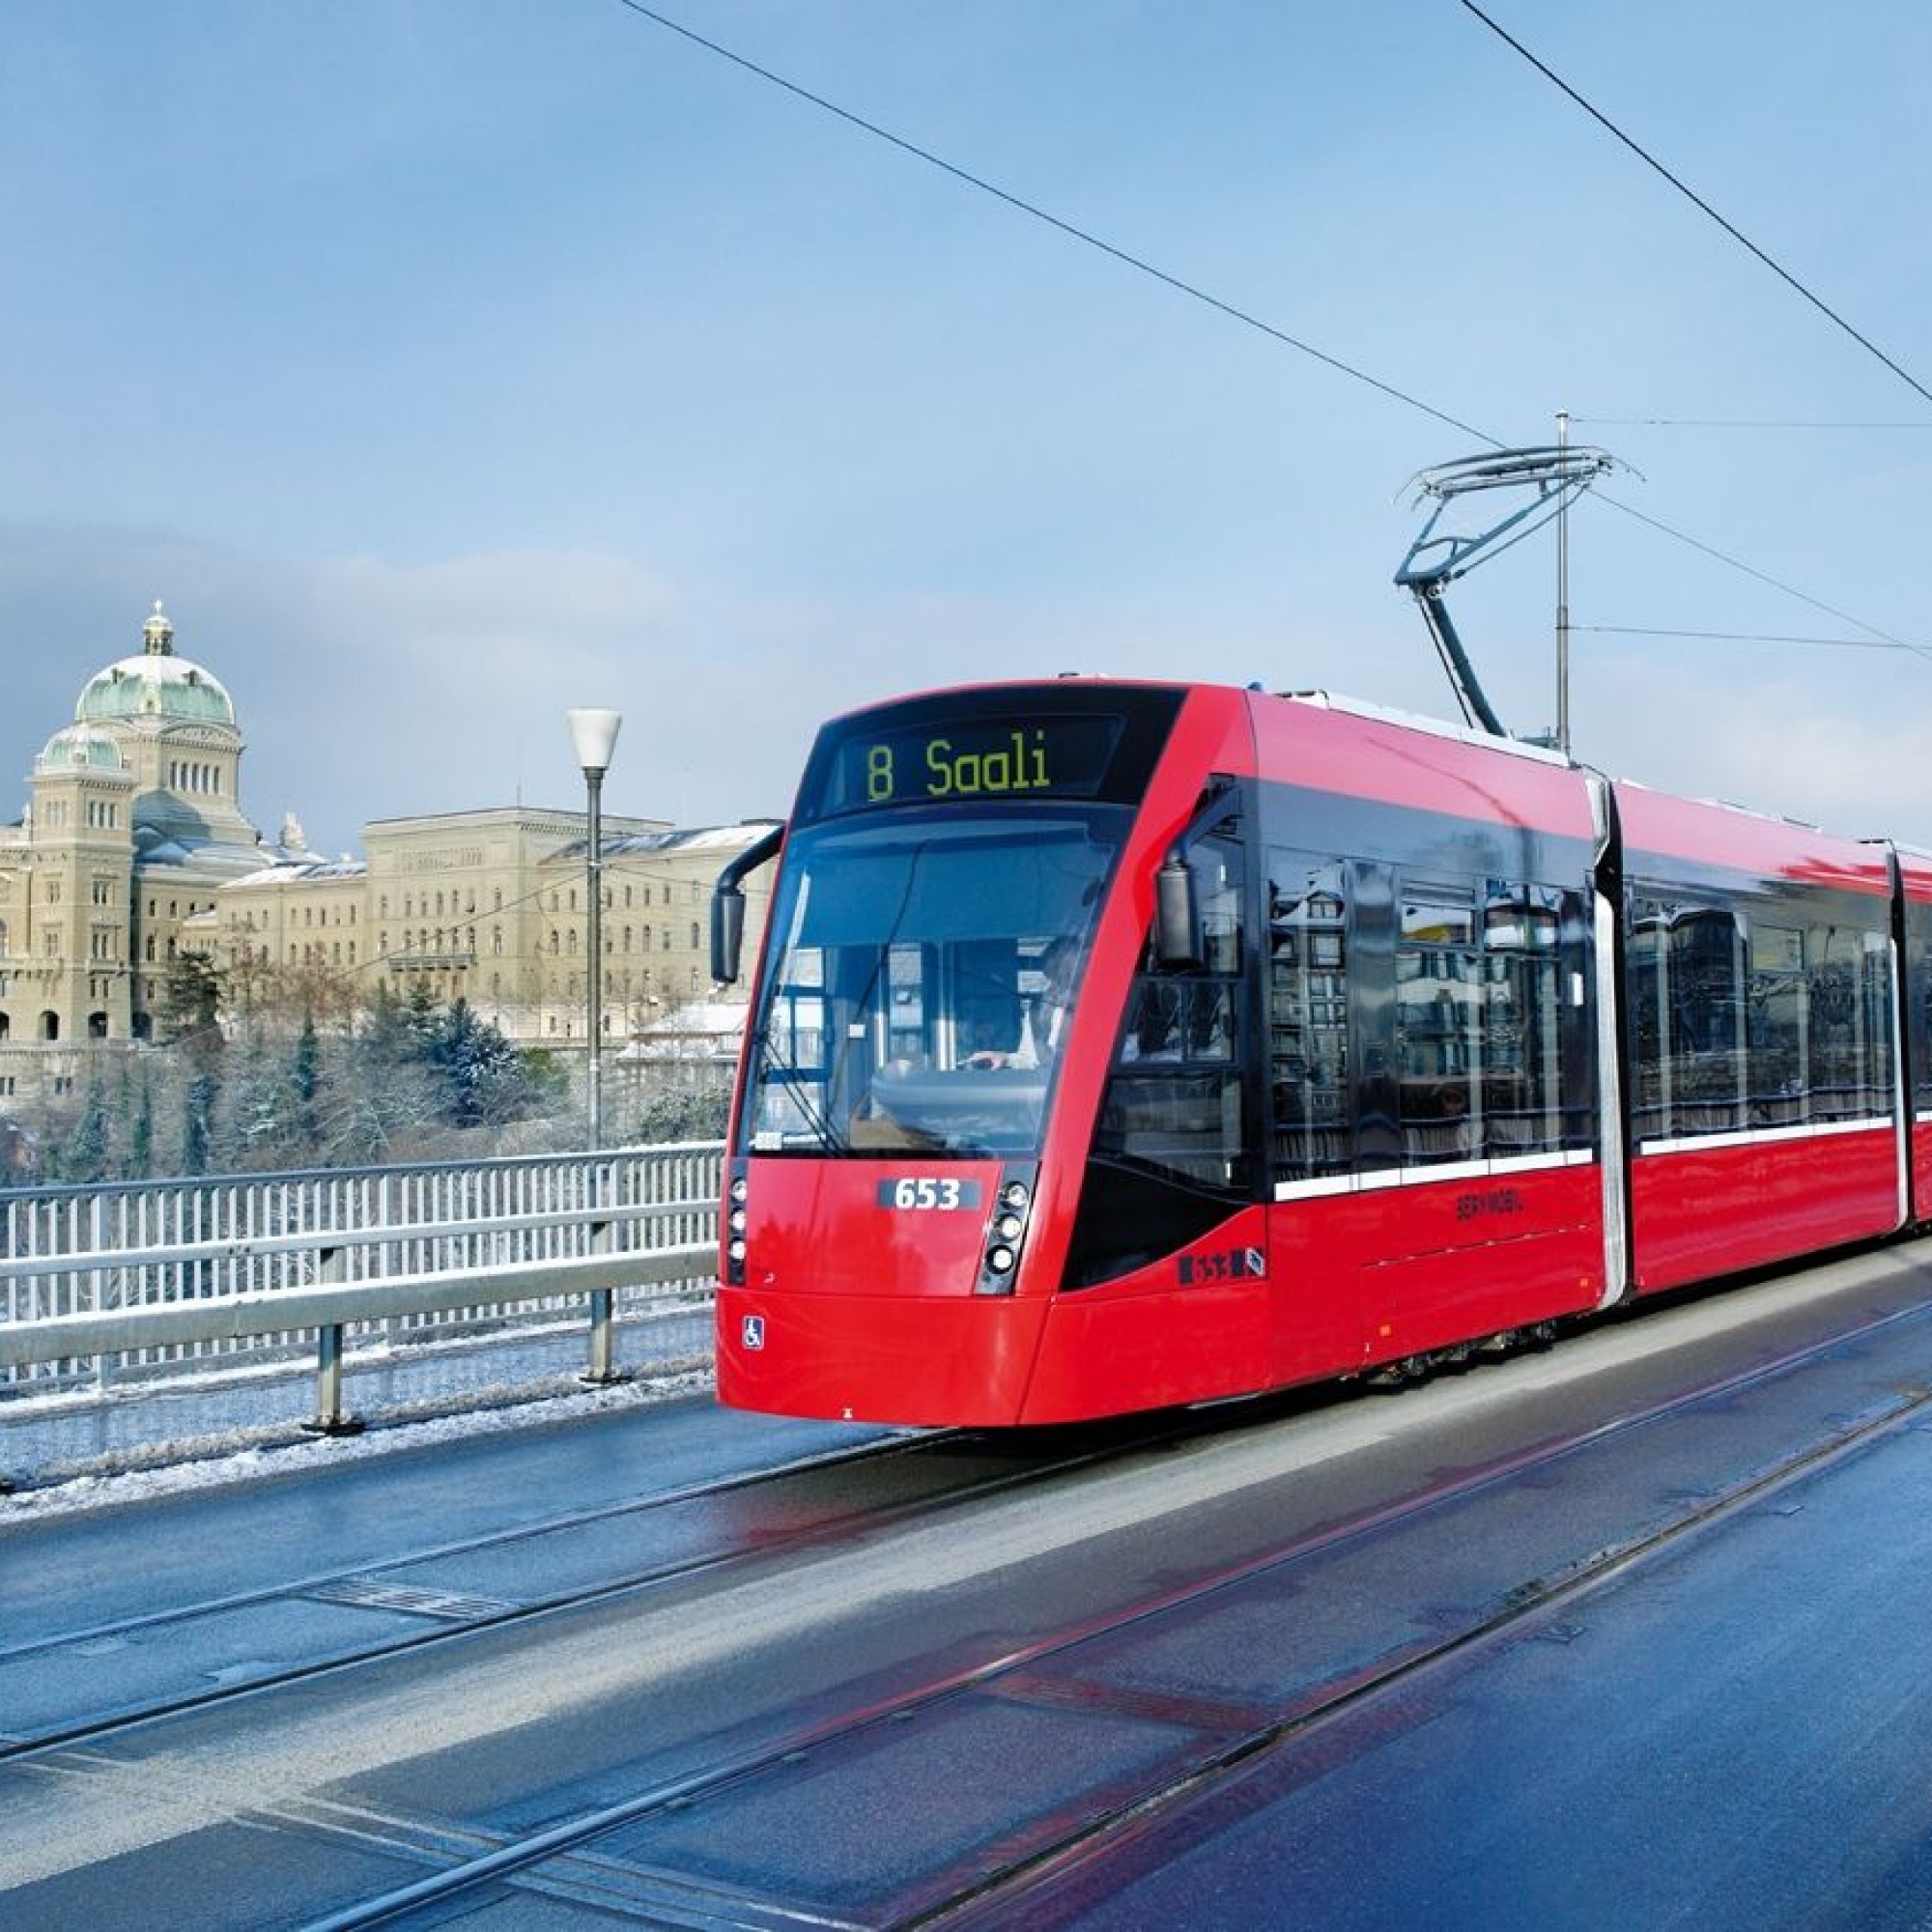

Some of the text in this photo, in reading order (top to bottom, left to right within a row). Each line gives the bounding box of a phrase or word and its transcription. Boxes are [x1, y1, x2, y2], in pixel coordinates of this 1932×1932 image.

[869, 730, 1049, 802] 8 Saali
[895, 1179, 959, 1209] 653
